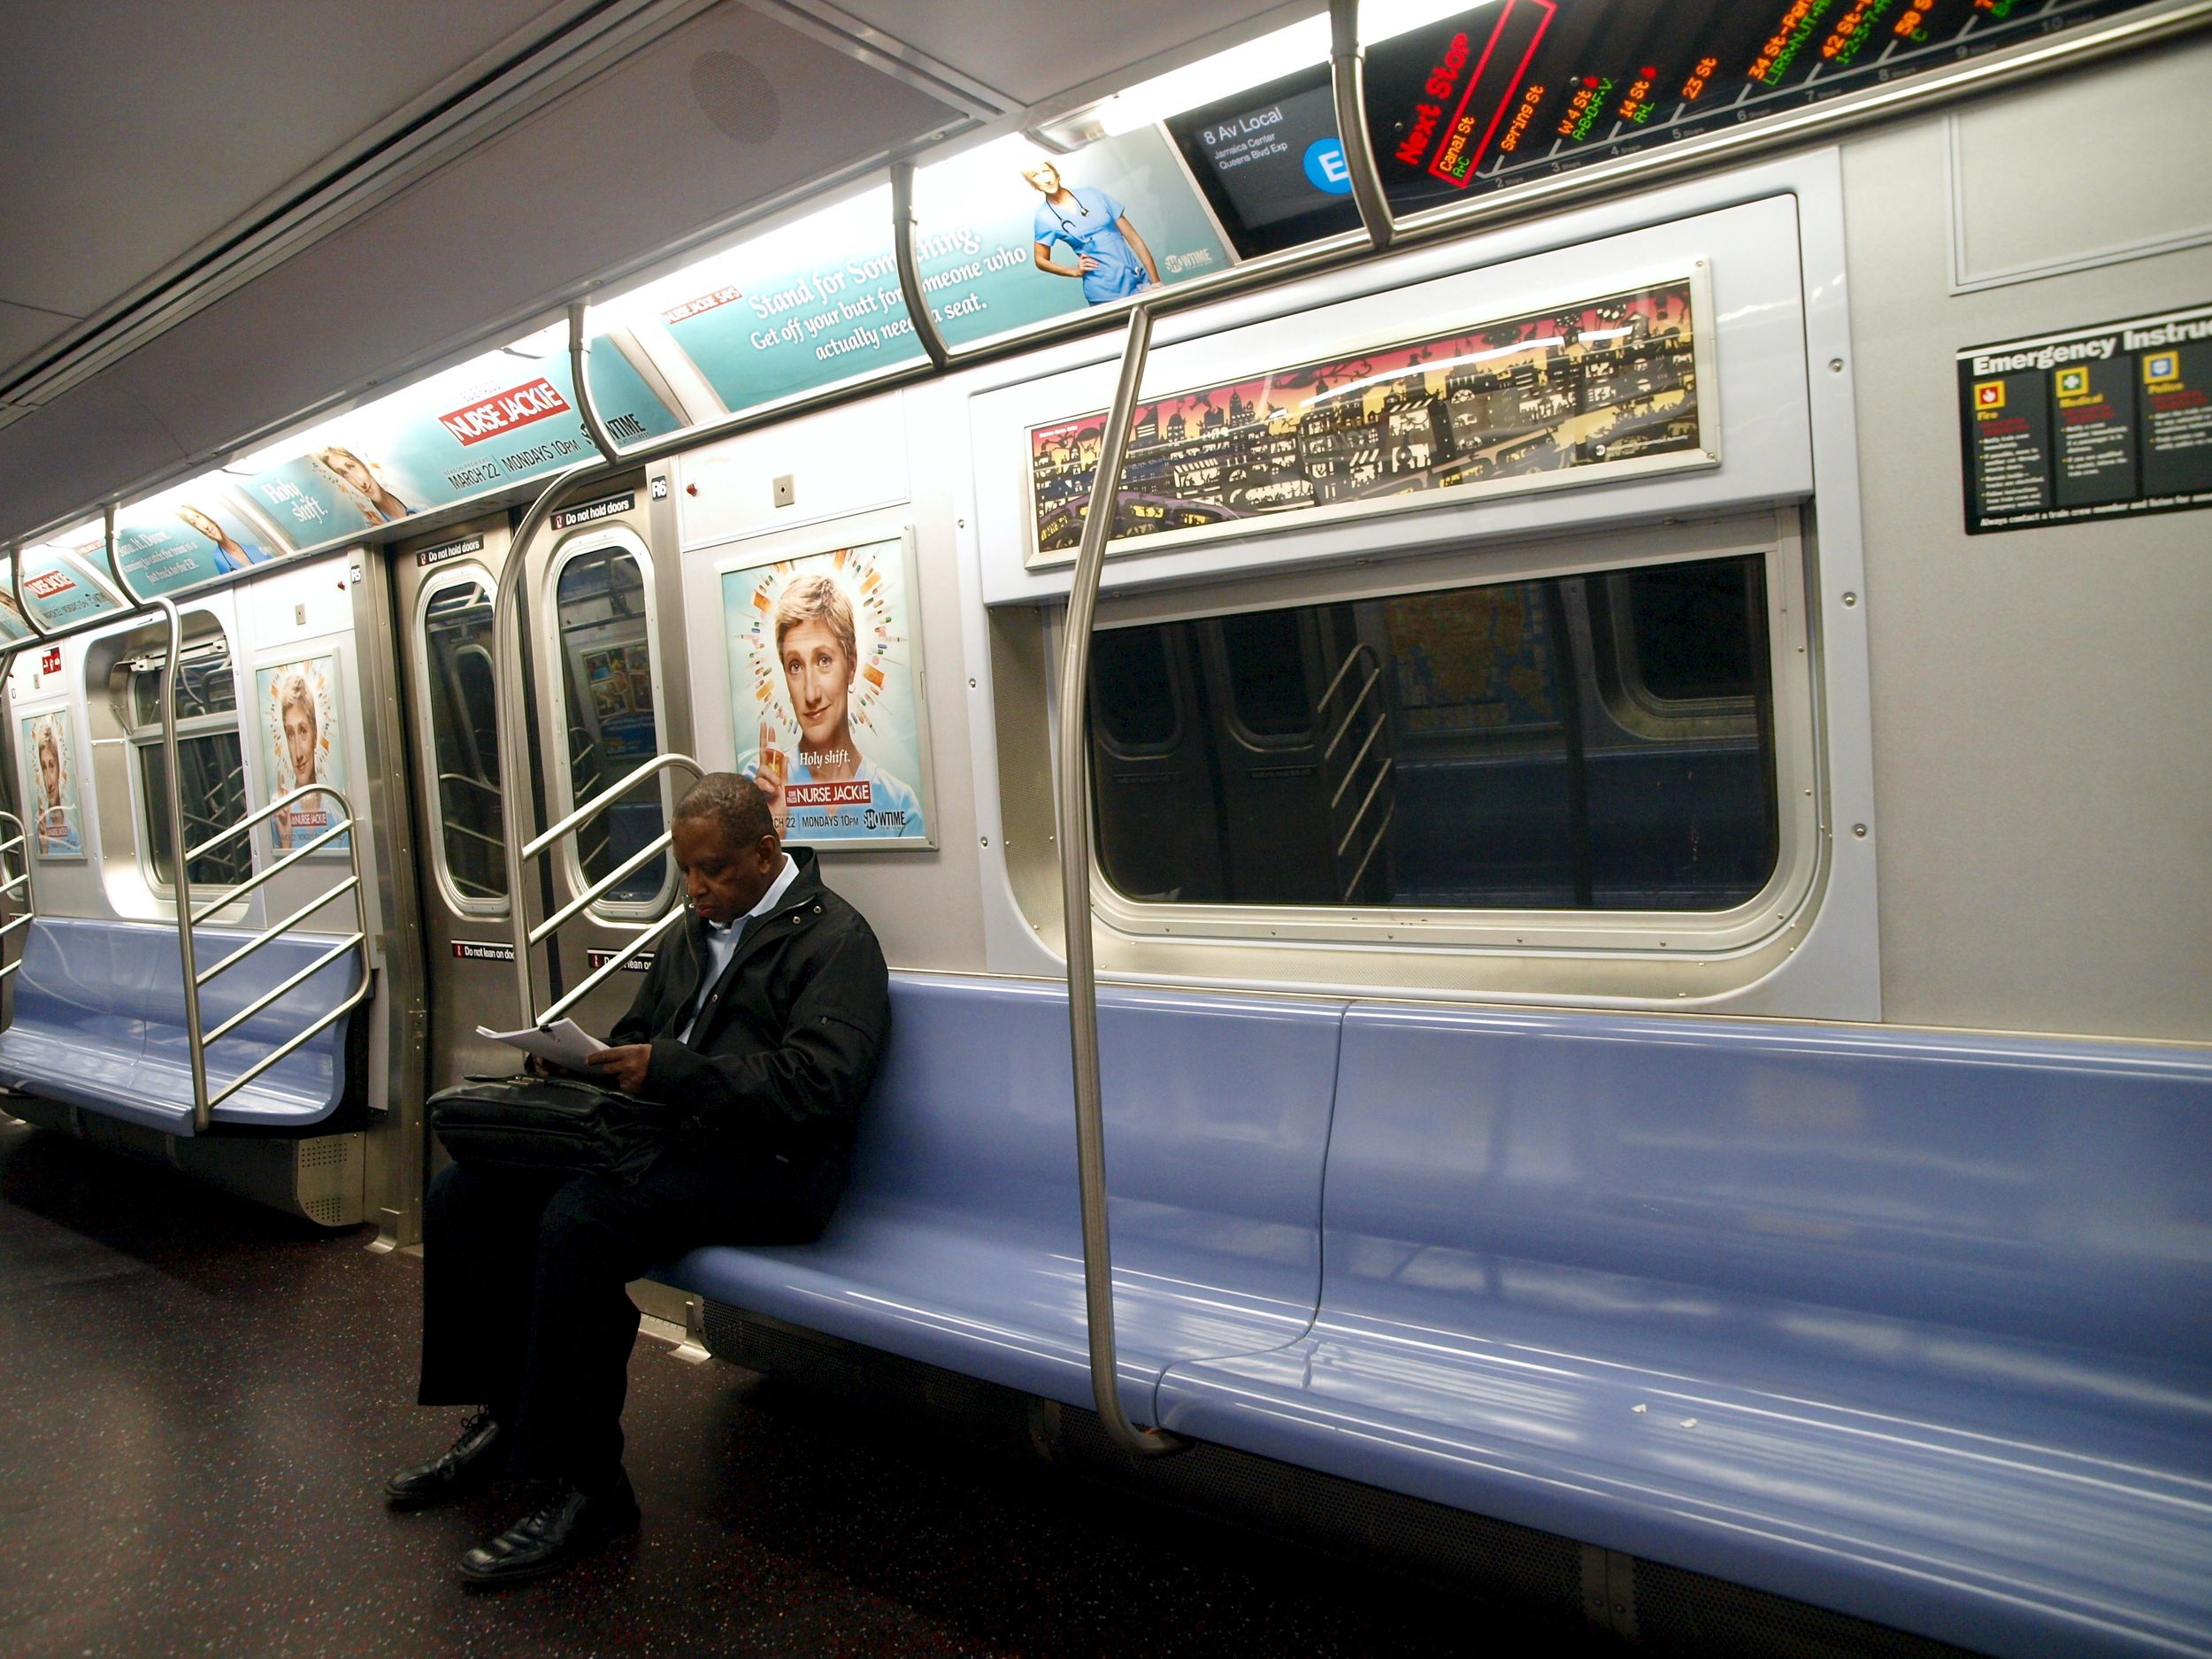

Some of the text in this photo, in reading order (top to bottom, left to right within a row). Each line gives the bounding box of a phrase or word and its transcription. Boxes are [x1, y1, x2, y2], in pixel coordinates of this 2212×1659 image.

[1822, 35, 1847, 58] 42
[1682, 57, 1717, 100] 23 St
[1748, 57, 1771, 80] 34
[1395, 31, 1471, 165] Next Stop
[1619, 80, 1649, 119] 14 St
[1501, 85, 1544, 151] Spring St
[1557, 89, 1592, 135] W 4 St
[1737, 110, 1747, 121] 6
[1203, 106, 1284, 145] 8 Av Local
[1672, 129, 1681, 139] 5
[1214, 133, 1275, 159] Jamaica Center
[1219, 142, 1288, 170] Queens Blvd Exp
[1440, 116, 1476, 172] Canal St
[1611, 146, 1619, 156] 4
[1318, 150, 1348, 182] E
[1551, 163, 1560, 173] 3
[1495, 178, 1503, 188] 2
[749, 227, 982, 319] Stand for Somhing.
[1164, 249, 1212, 273] SHOWTIME
[750, 246, 1026, 349] Get off your butt for meone who
[816, 326, 880, 361] actually
[944, 292, 987, 319] seat.
[1972, 337, 2117, 376] Emergency
[443, 404, 509, 441] NURSE
[498, 383, 564, 422] JACKIE
[448, 440, 580, 489] MARCH 22 MONDAYS 10PM
[261, 478, 306, 504] Holy
[651, 480, 666, 498] R6
[291, 495, 328, 524] shift.
[566, 500, 629, 525] Do not hold doors
[428, 541, 480, 562] Do not hold doors
[800, 749, 851, 769] Holy shift.
[797, 785, 870, 803] NURSE JACKIE
[787, 818, 795, 828] 22
[803, 816, 839, 827] MONDAYS
[841, 815, 859, 826] 10PM
[864, 809, 906, 830] SHOWTIME
[465, 946, 473, 956] Do
[473, 948, 483, 957] not
[483, 948, 495, 958] lean
